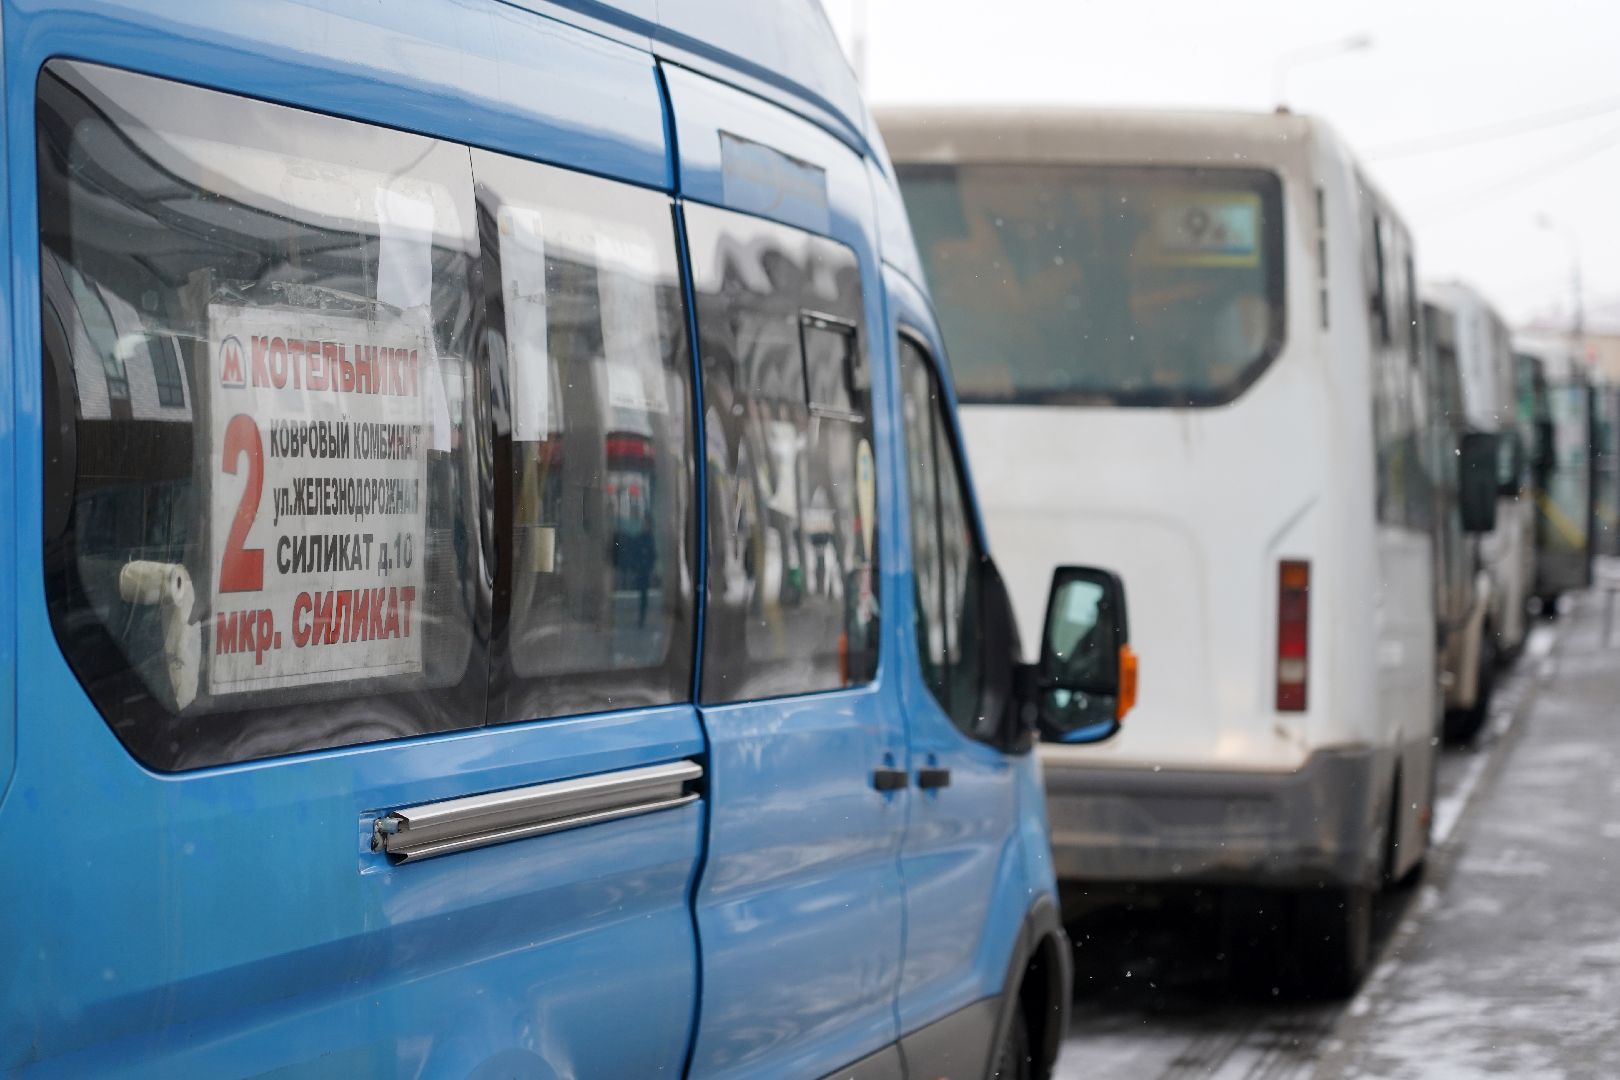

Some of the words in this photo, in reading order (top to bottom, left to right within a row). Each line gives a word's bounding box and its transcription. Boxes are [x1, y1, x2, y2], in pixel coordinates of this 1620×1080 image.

[251, 335, 418, 396] КОТЕЛЬНИКИ
[270, 413, 350, 458] КОВРОВЫЙ
[219, 413, 265, 593] 2
[276, 533, 374, 575] СИЛИКАТ
[215, 608, 282, 666] мкр.
[291, 585, 416, 648] СИЛИКАТ
